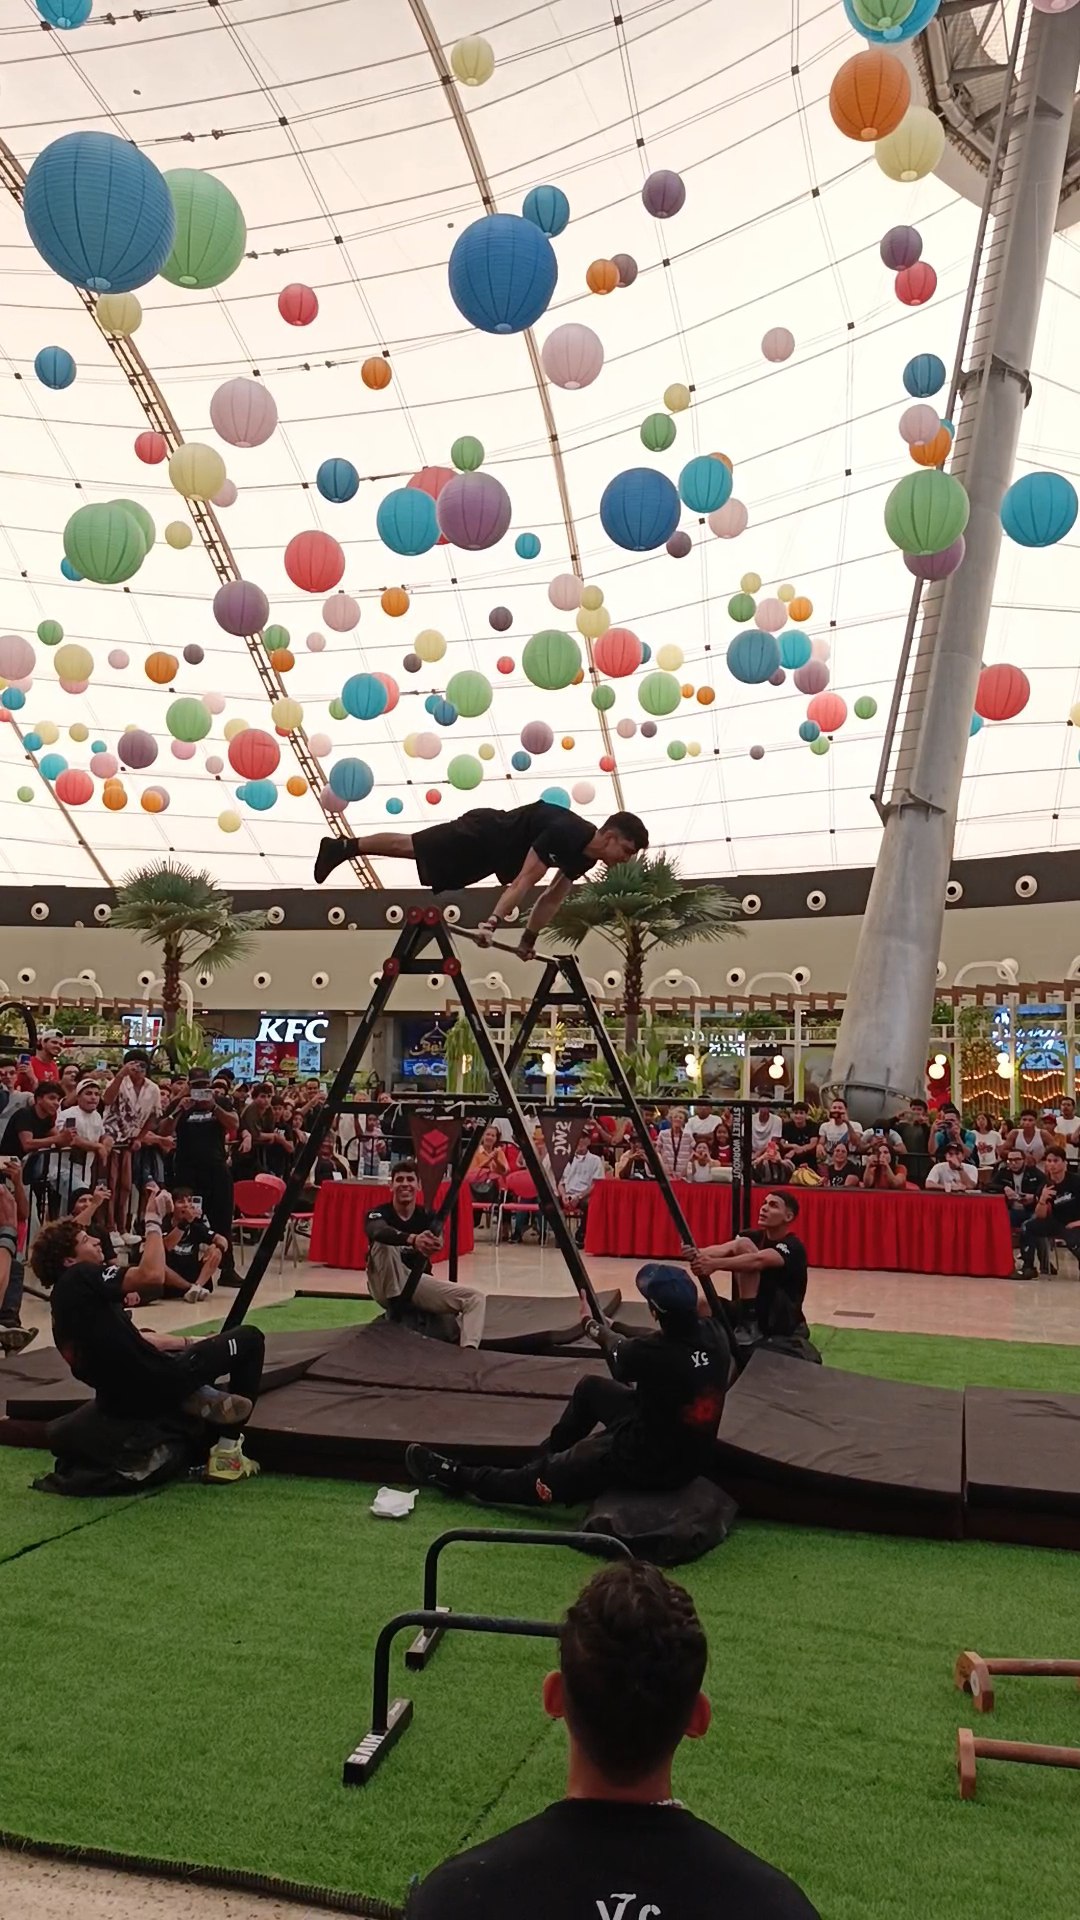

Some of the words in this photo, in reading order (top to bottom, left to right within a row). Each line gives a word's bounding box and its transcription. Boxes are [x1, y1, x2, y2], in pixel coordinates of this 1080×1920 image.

[255, 1018, 329, 1043] KFC
[732, 1107, 742, 1138] STREET
[732, 1139, 742, 1179] WORKOUT
[346, 1733, 386, 1765] HIVE
